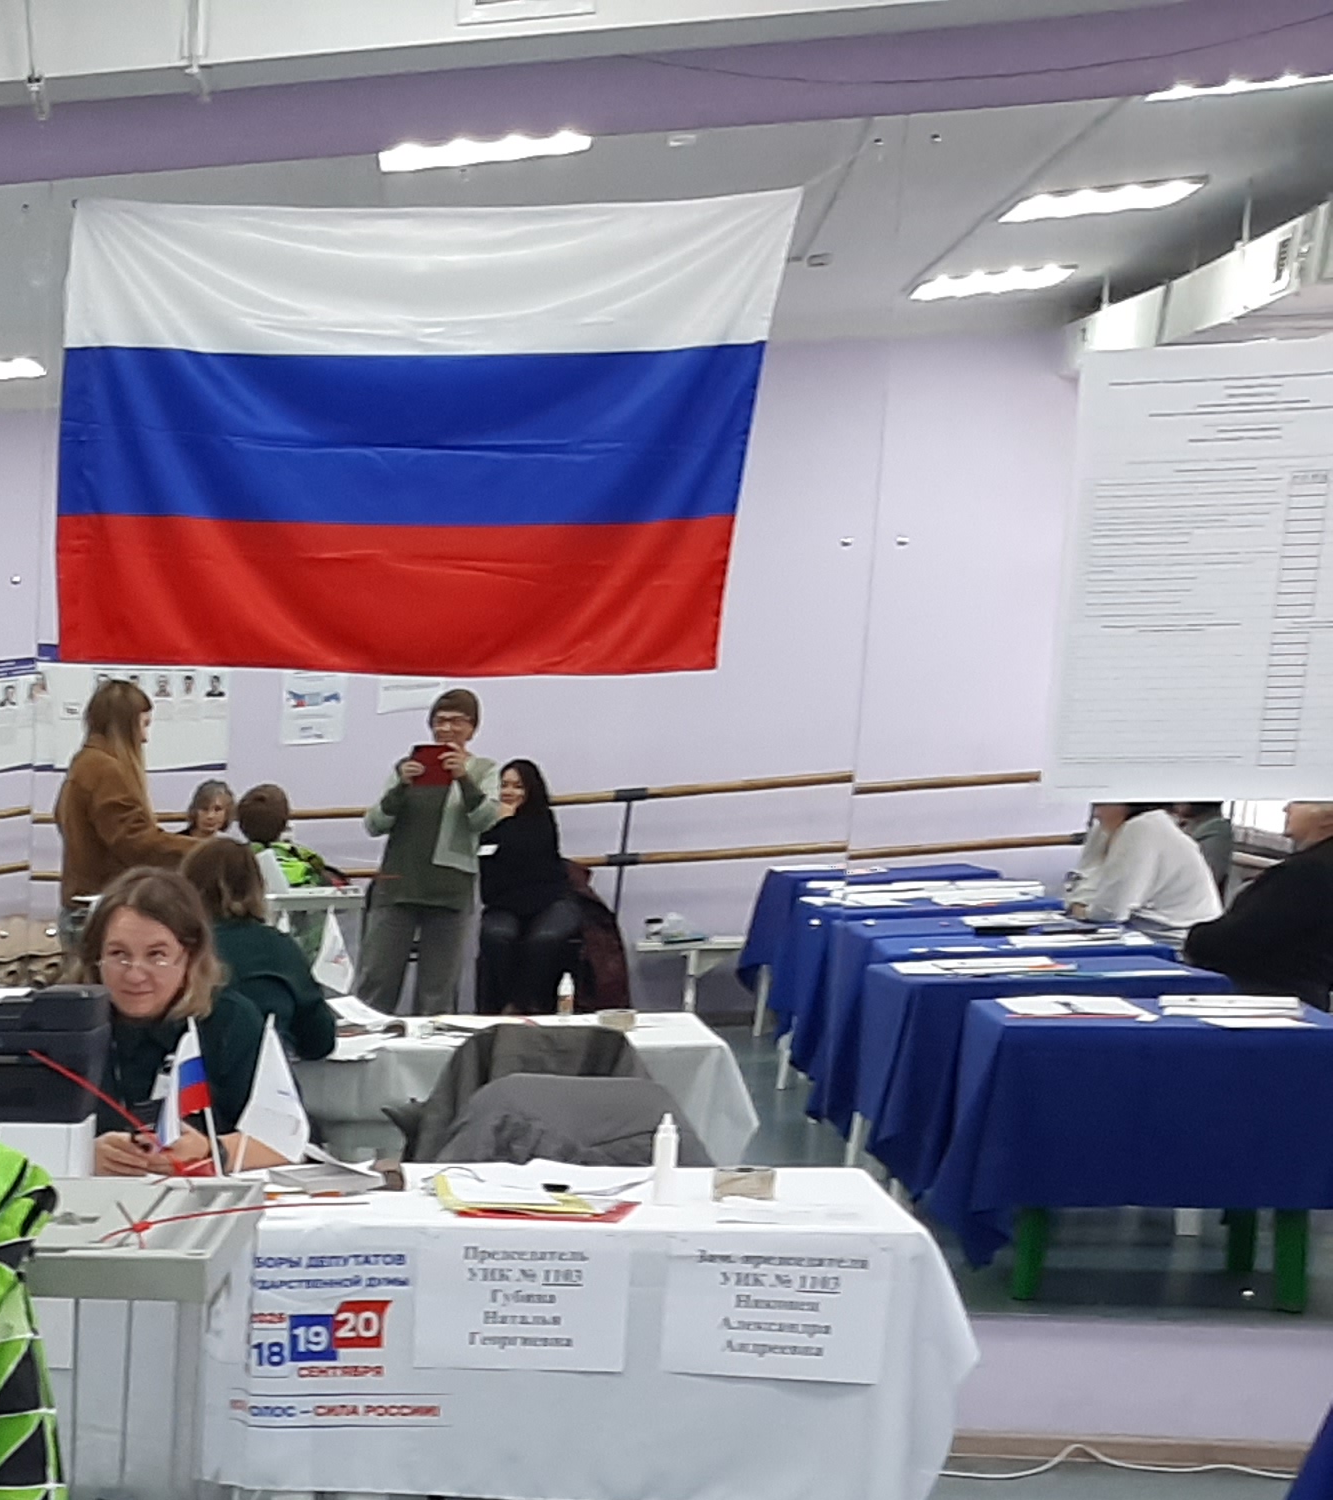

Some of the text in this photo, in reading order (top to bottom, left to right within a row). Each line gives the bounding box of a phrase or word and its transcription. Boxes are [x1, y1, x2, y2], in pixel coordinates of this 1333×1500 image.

[306, 1253, 406, 1269] ДЕПУТАТОВ
[463, 1245, 590, 1264] Председатель
[365, 1277, 410, 1288] ДУМЫ
[467, 1268, 513, 1282] УИК
[516, 1269, 537, 1282] №
[719, 1272, 768, 1287] УИК
[251, 1311, 380, 1367] 18 19 20
[468, 1332, 574, 1349] Георгиевна
[297, 1365, 384, 1378] СЕНТЯБРЯ
[313, 1405, 360, 1417] СИЛА
